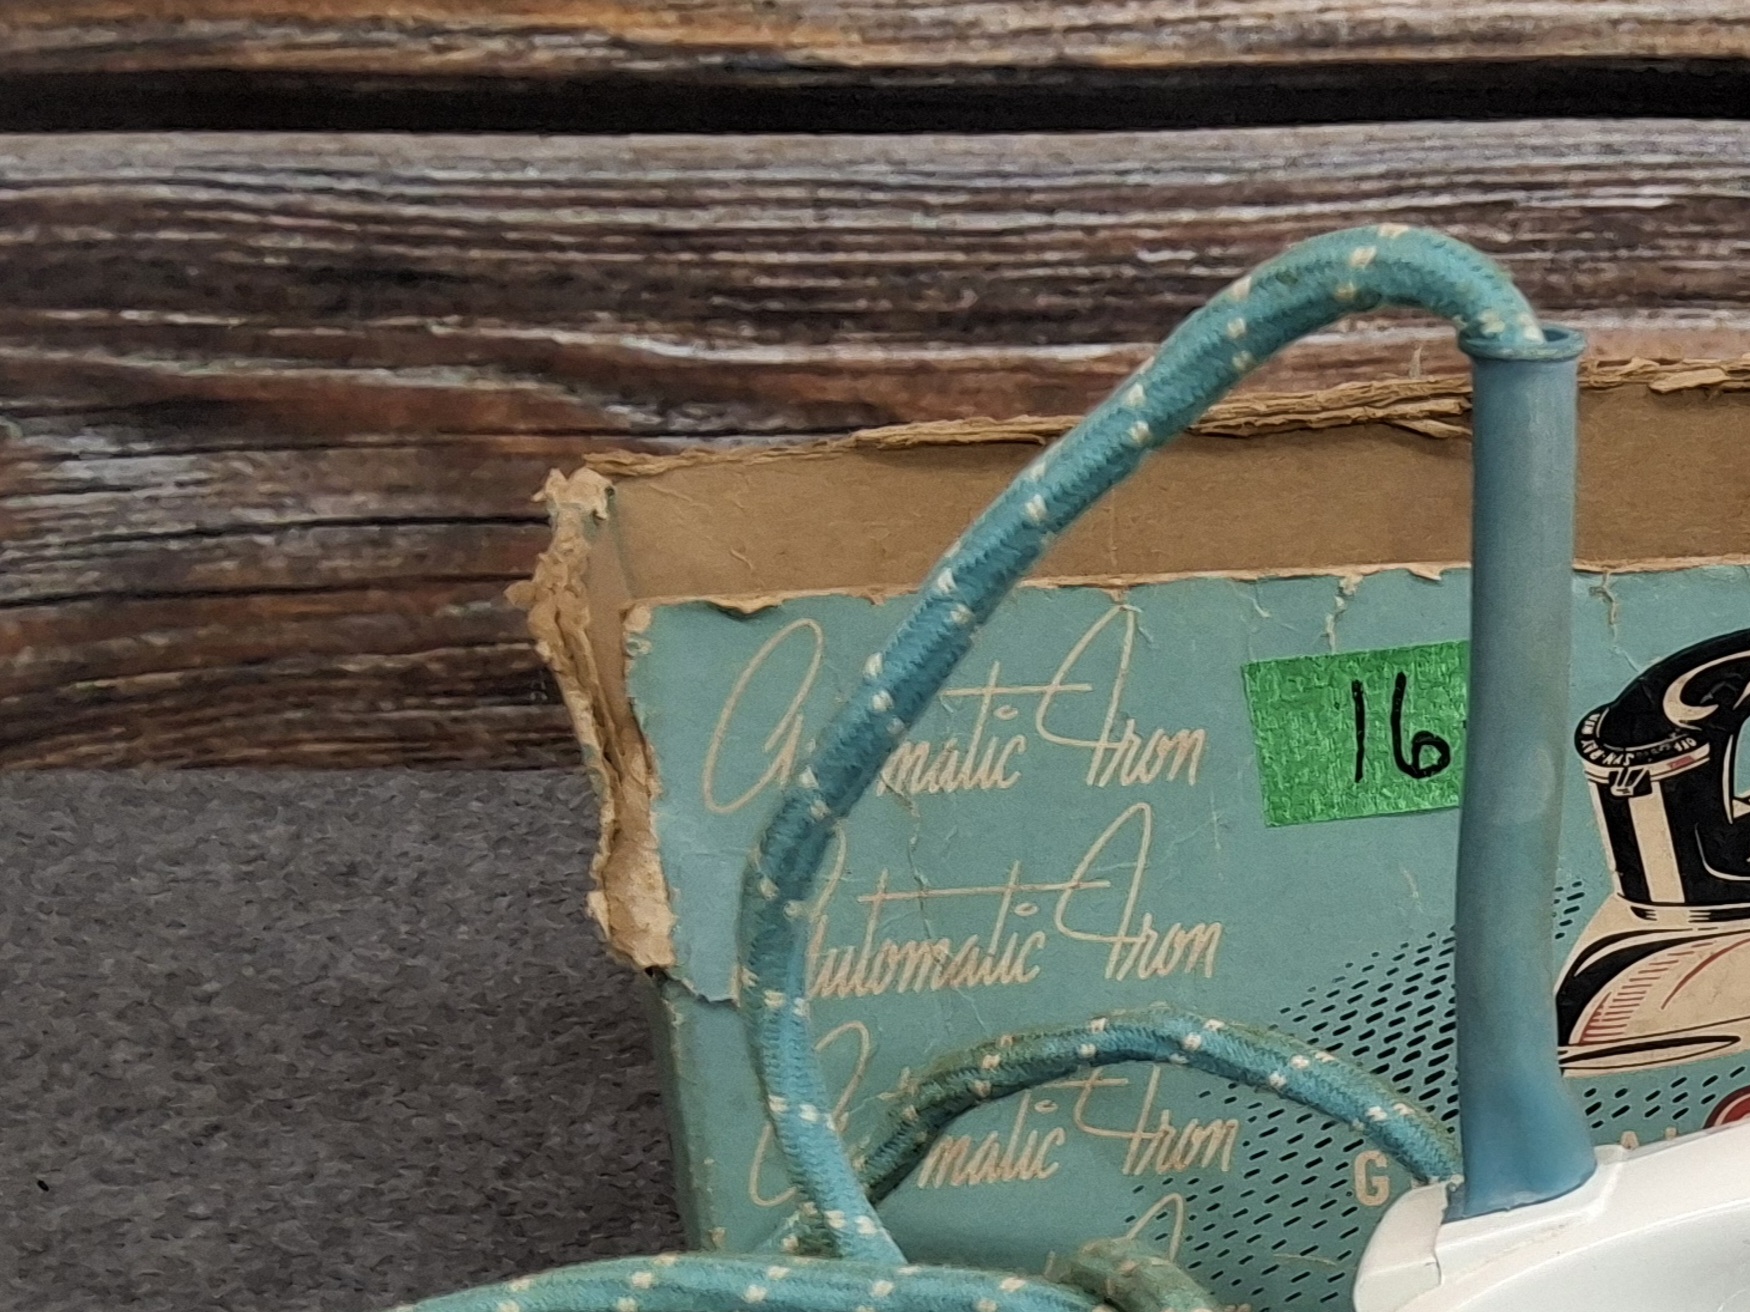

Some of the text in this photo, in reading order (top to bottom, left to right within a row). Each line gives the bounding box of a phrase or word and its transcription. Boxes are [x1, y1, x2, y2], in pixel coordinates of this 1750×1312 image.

[1035, 603, 1205, 788] Iron
[1351, 671, 1451, 783] 16
[1054, 803, 1225, 982] Iron
